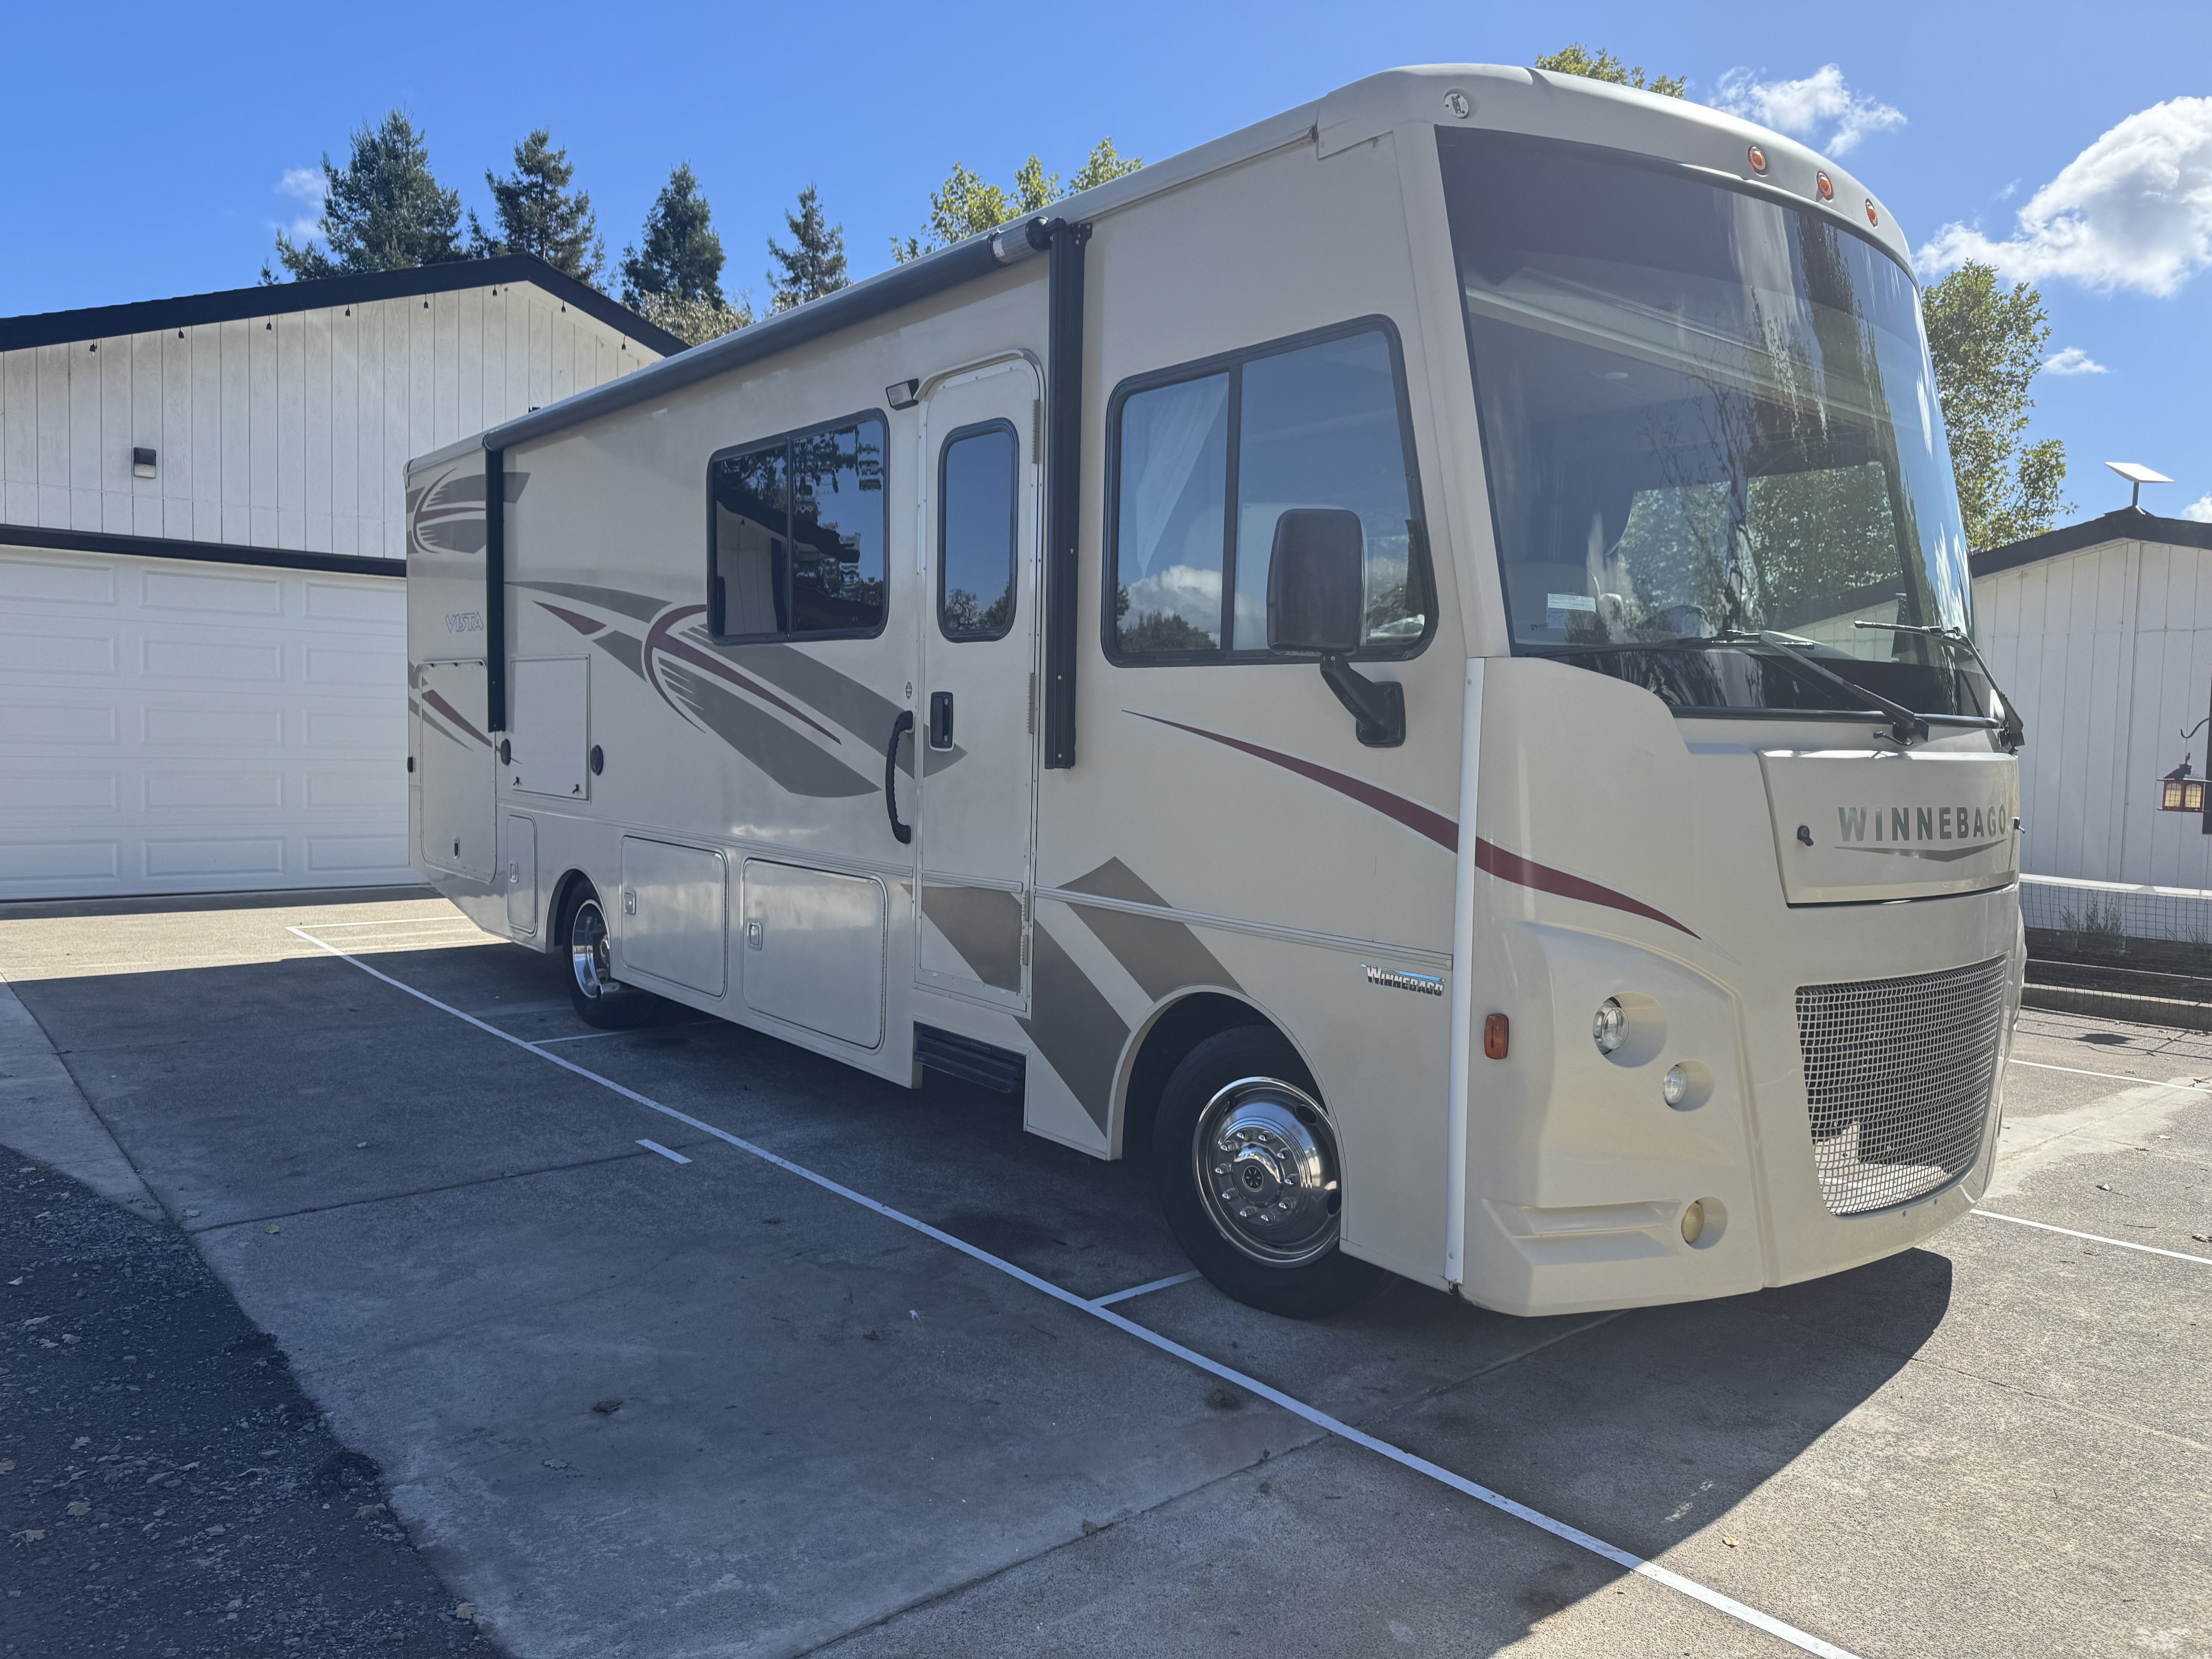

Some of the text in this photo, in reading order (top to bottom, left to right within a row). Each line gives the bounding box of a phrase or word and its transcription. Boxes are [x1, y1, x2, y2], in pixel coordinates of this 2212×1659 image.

[445, 611, 484, 634] VISTA
[1838, 804, 2006, 842] WINNEBAGO
[1366, 964, 1444, 996] WINNEBAGO
